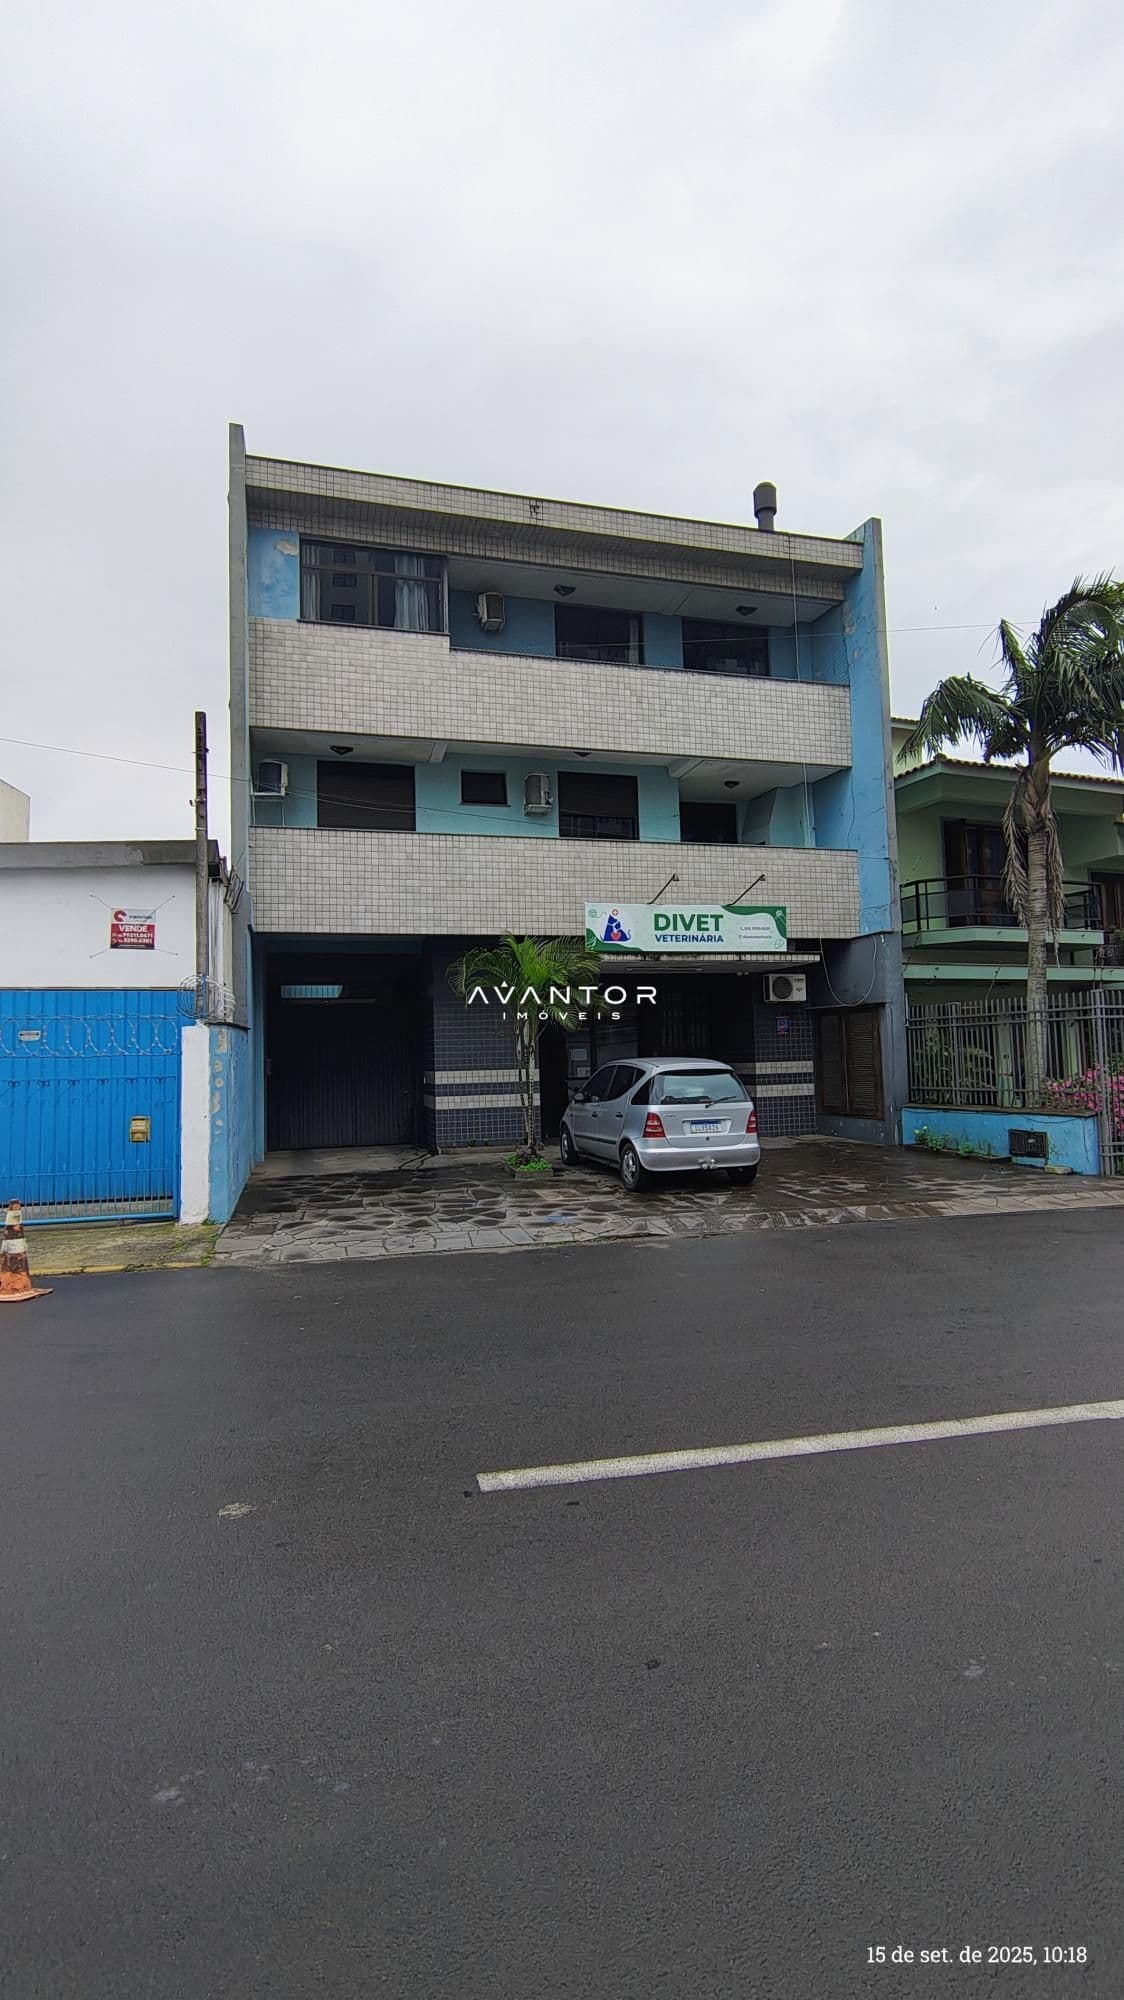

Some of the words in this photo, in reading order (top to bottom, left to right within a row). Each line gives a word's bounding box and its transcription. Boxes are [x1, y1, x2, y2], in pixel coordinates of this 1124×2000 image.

[654, 913, 724, 931] DIVET
[118, 924, 148, 932] VENDE
[655, 933, 724, 943] VETERINÁRIA
